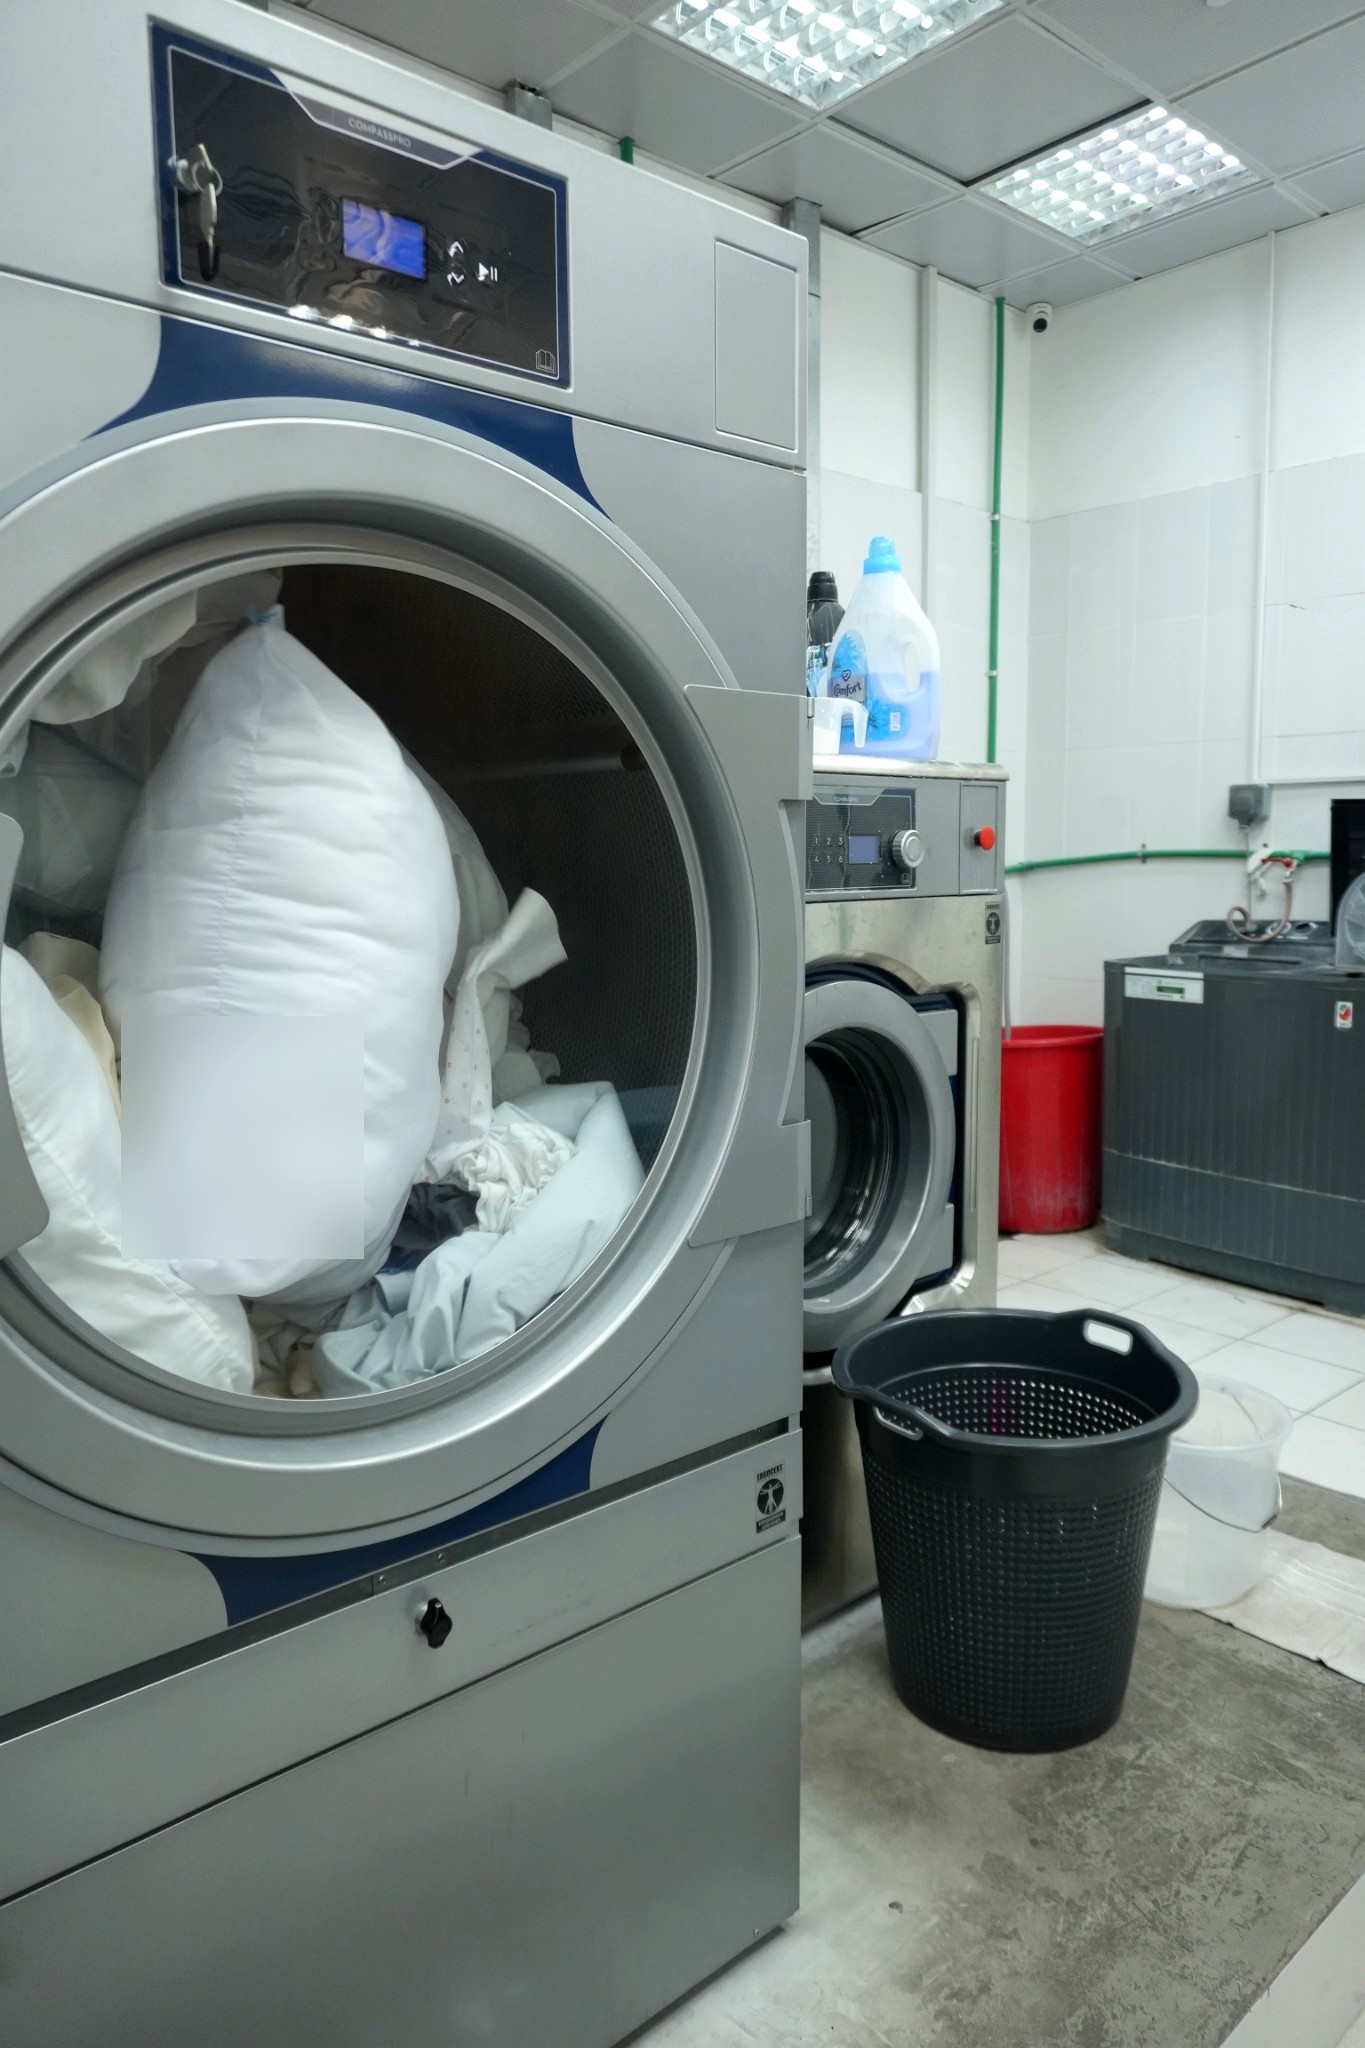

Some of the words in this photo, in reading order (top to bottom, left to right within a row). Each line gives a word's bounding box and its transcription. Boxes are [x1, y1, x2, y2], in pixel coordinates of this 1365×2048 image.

[348, 118, 412, 148] COMPASSPRO
[833, 681, 862, 697] Comfort
[826, 837, 831, 845] 2
[838, 837, 843, 845] 3
[814, 855, 819, 863] 4
[826, 855, 831, 863] 5
[838, 855, 843, 863] 6
